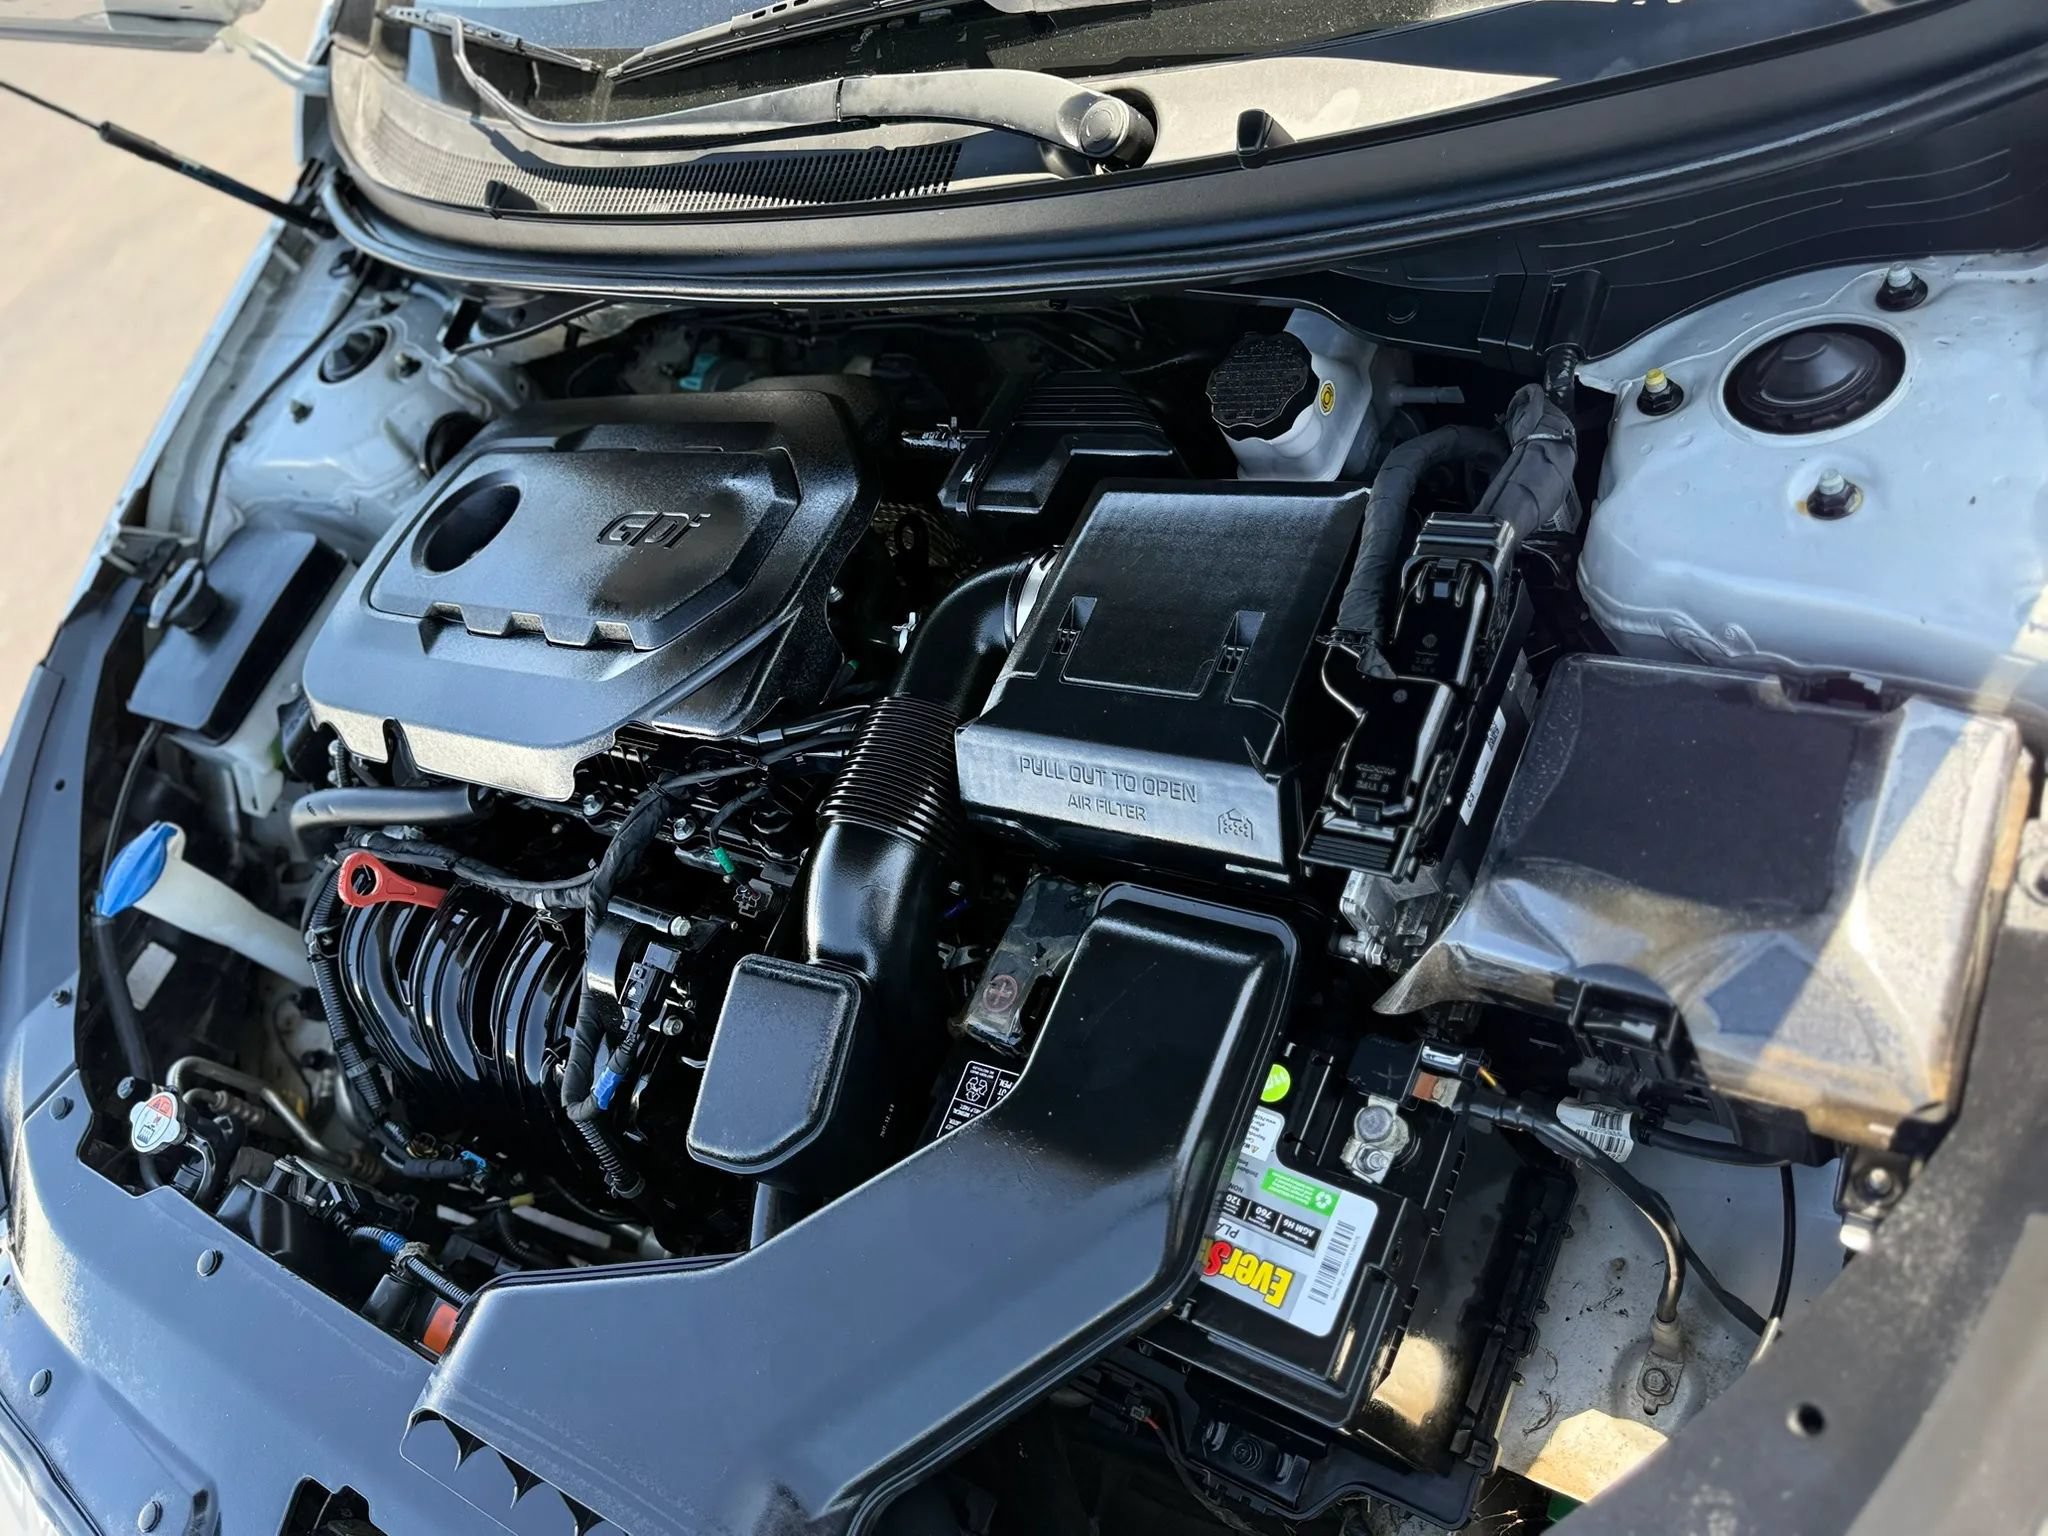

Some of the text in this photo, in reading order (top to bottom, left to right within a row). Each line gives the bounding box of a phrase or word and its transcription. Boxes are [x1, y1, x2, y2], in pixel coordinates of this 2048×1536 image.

[1019, 755, 1198, 803] PULL OUT TO OPEN
[1067, 794, 1147, 821] AIR FILTER
[1226, 1194, 1241, 1206] 120
[1255, 1206, 1273, 1220] 760
[1283, 1219, 1316, 1238] AGM H6
